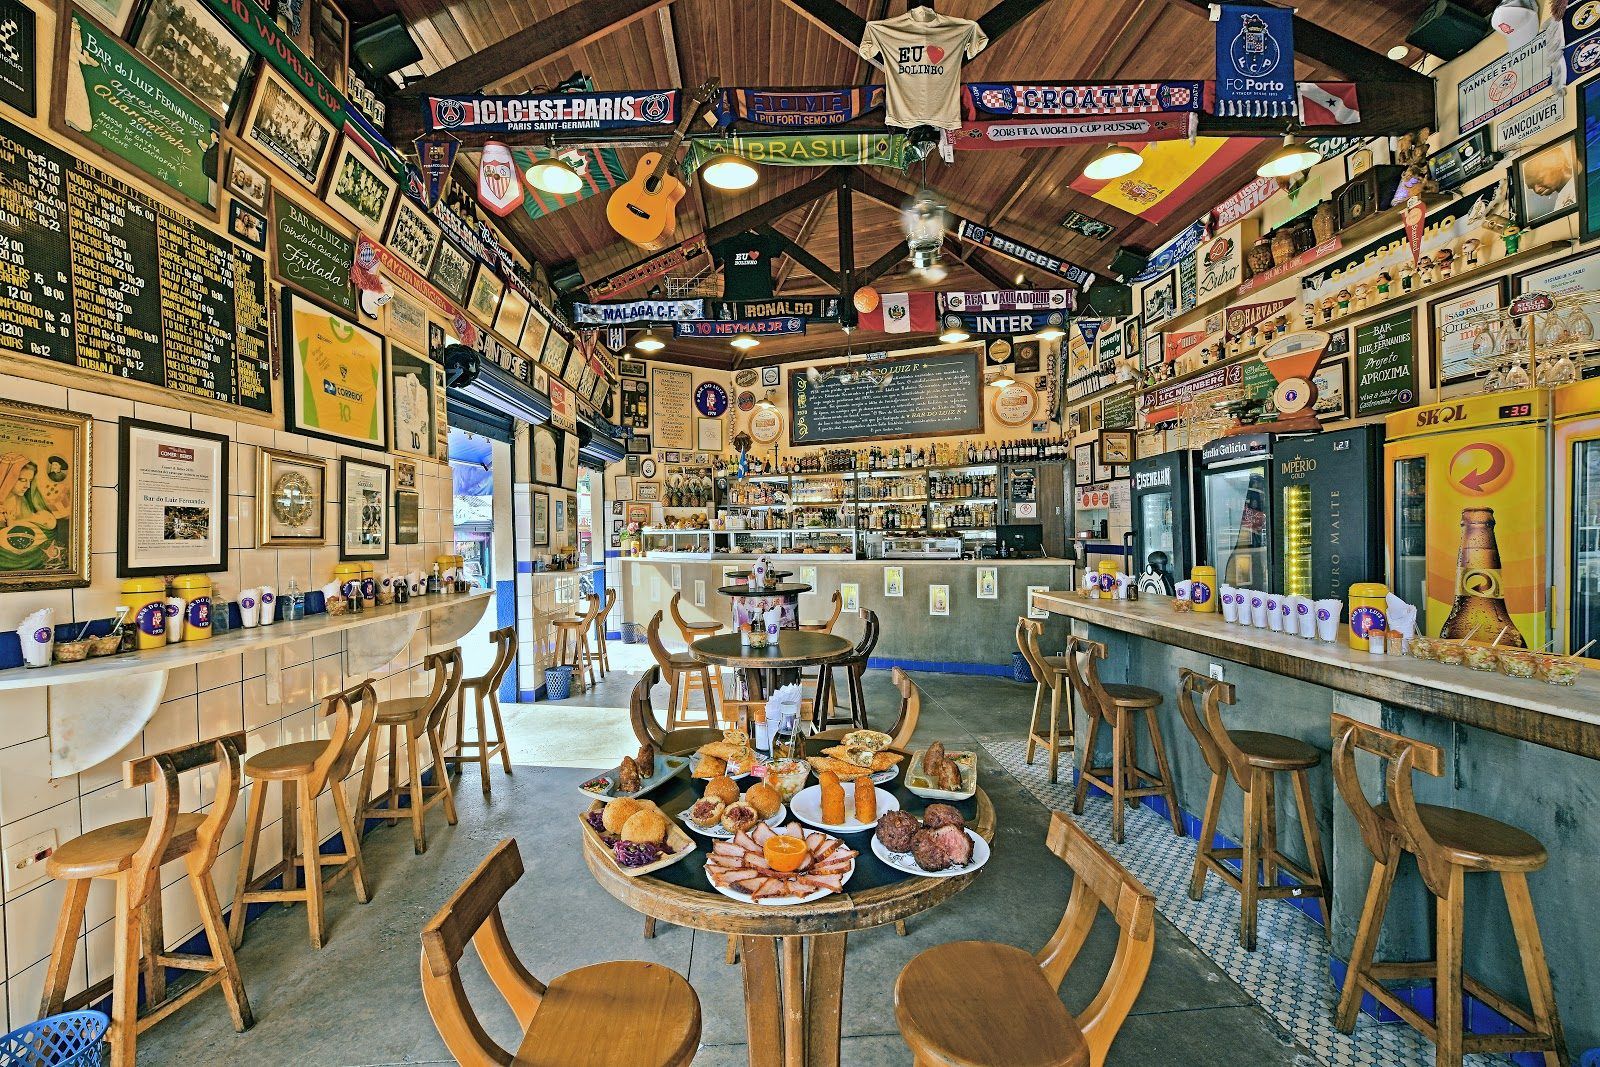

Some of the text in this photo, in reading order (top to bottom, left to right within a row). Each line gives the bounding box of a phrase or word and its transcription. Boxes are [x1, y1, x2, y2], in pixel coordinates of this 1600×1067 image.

[255, 15, 315, 88] WORLD
[317, 82, 341, 112] CUP
[898, 45, 925, 64] EU
[898, 64, 945, 76] BOLINHO
[1462, 39, 1549, 96] YANKEE STADIUM
[85, 33, 205, 133] BAR do LUIZ FERNANDES
[1225, 78, 1285, 91] FC Porto
[110, 79, 185, 136] apresenta
[1022, 87, 1153, 111] CROATIA
[94, 84, 193, 157] Quarentinha
[473, 99, 504, 126] ICI
[571, 95, 636, 121] PARIS
[776, 114, 845, 125] FORTI SEMO NOI
[99, 111, 122, 130] MASSA
[133, 133, 161, 155] BATATA
[507, 119, 600, 132] PARIS SAINT-GERMAIN
[992, 124, 1102, 138] 2018 FIFA WORLD CUP
[1502, 103, 1558, 142] VANCOUVER
[1517, 125, 1542, 141] CANADA
[96, 118, 120, 135] MIOLO
[133, 141, 177, 171] ALCACHOFRA
[102, 130, 129, 149] ALICHE
[748, 139, 852, 161] BRASIL
[76, 159, 96, 180] BAR
[93, 184, 127, 207] SMIRNOFF
[1216, 192, 1239, 213] SPORT
[1218, 177, 1280, 227] BENFICA
[71, 218, 102, 239] BACARDI
[289, 205, 310, 231] BAR
[319, 225, 342, 250] LUIZ
[478, 220, 515, 269] Budweiser
[991, 235, 1061, 272] BRUGGE
[282, 243, 344, 287] Fritada
[734, 252, 749, 262] EU
[380, 252, 414, 286] BAYERN
[964, 290, 1050, 306] REAL VALLADOLID
[1516, 299, 1545, 309] STELLA
[1516, 303, 1546, 314] ARTOIS
[603, 304, 678, 321] MALAGA C.F.
[744, 301, 814, 317] RONALDO
[1243, 300, 1285, 328] HARVARD
[696, 320, 783, 335] 10 NEYMAR JR
[975, 315, 1034, 333] INTER
[1372, 322, 1392, 337] BAR
[1100, 332, 1121, 348] Beverly
[1358, 332, 1411, 355] LUIZ FERNANDES
[476, 330, 518, 377] SANTOS
[1100, 349, 1116, 362] Hills
[1363, 351, 1399, 370] Projeto
[889, 365, 912, 374] LUIZ
[1359, 364, 1411, 387] APROXIMA
[696, 387, 705, 398] BAR
[338, 401, 352, 423] 10
[1416, 404, 1467, 427] SKOL
[410, 430, 421, 450] 10
[1219, 441, 1248, 456] Galicia
[160, 450, 177, 458] COMER
[1136, 466, 1172, 490] EISENBAHN
[1290, 472, 1305, 480] GOLD
[1328, 490, 1341, 601] PURO MALTE
